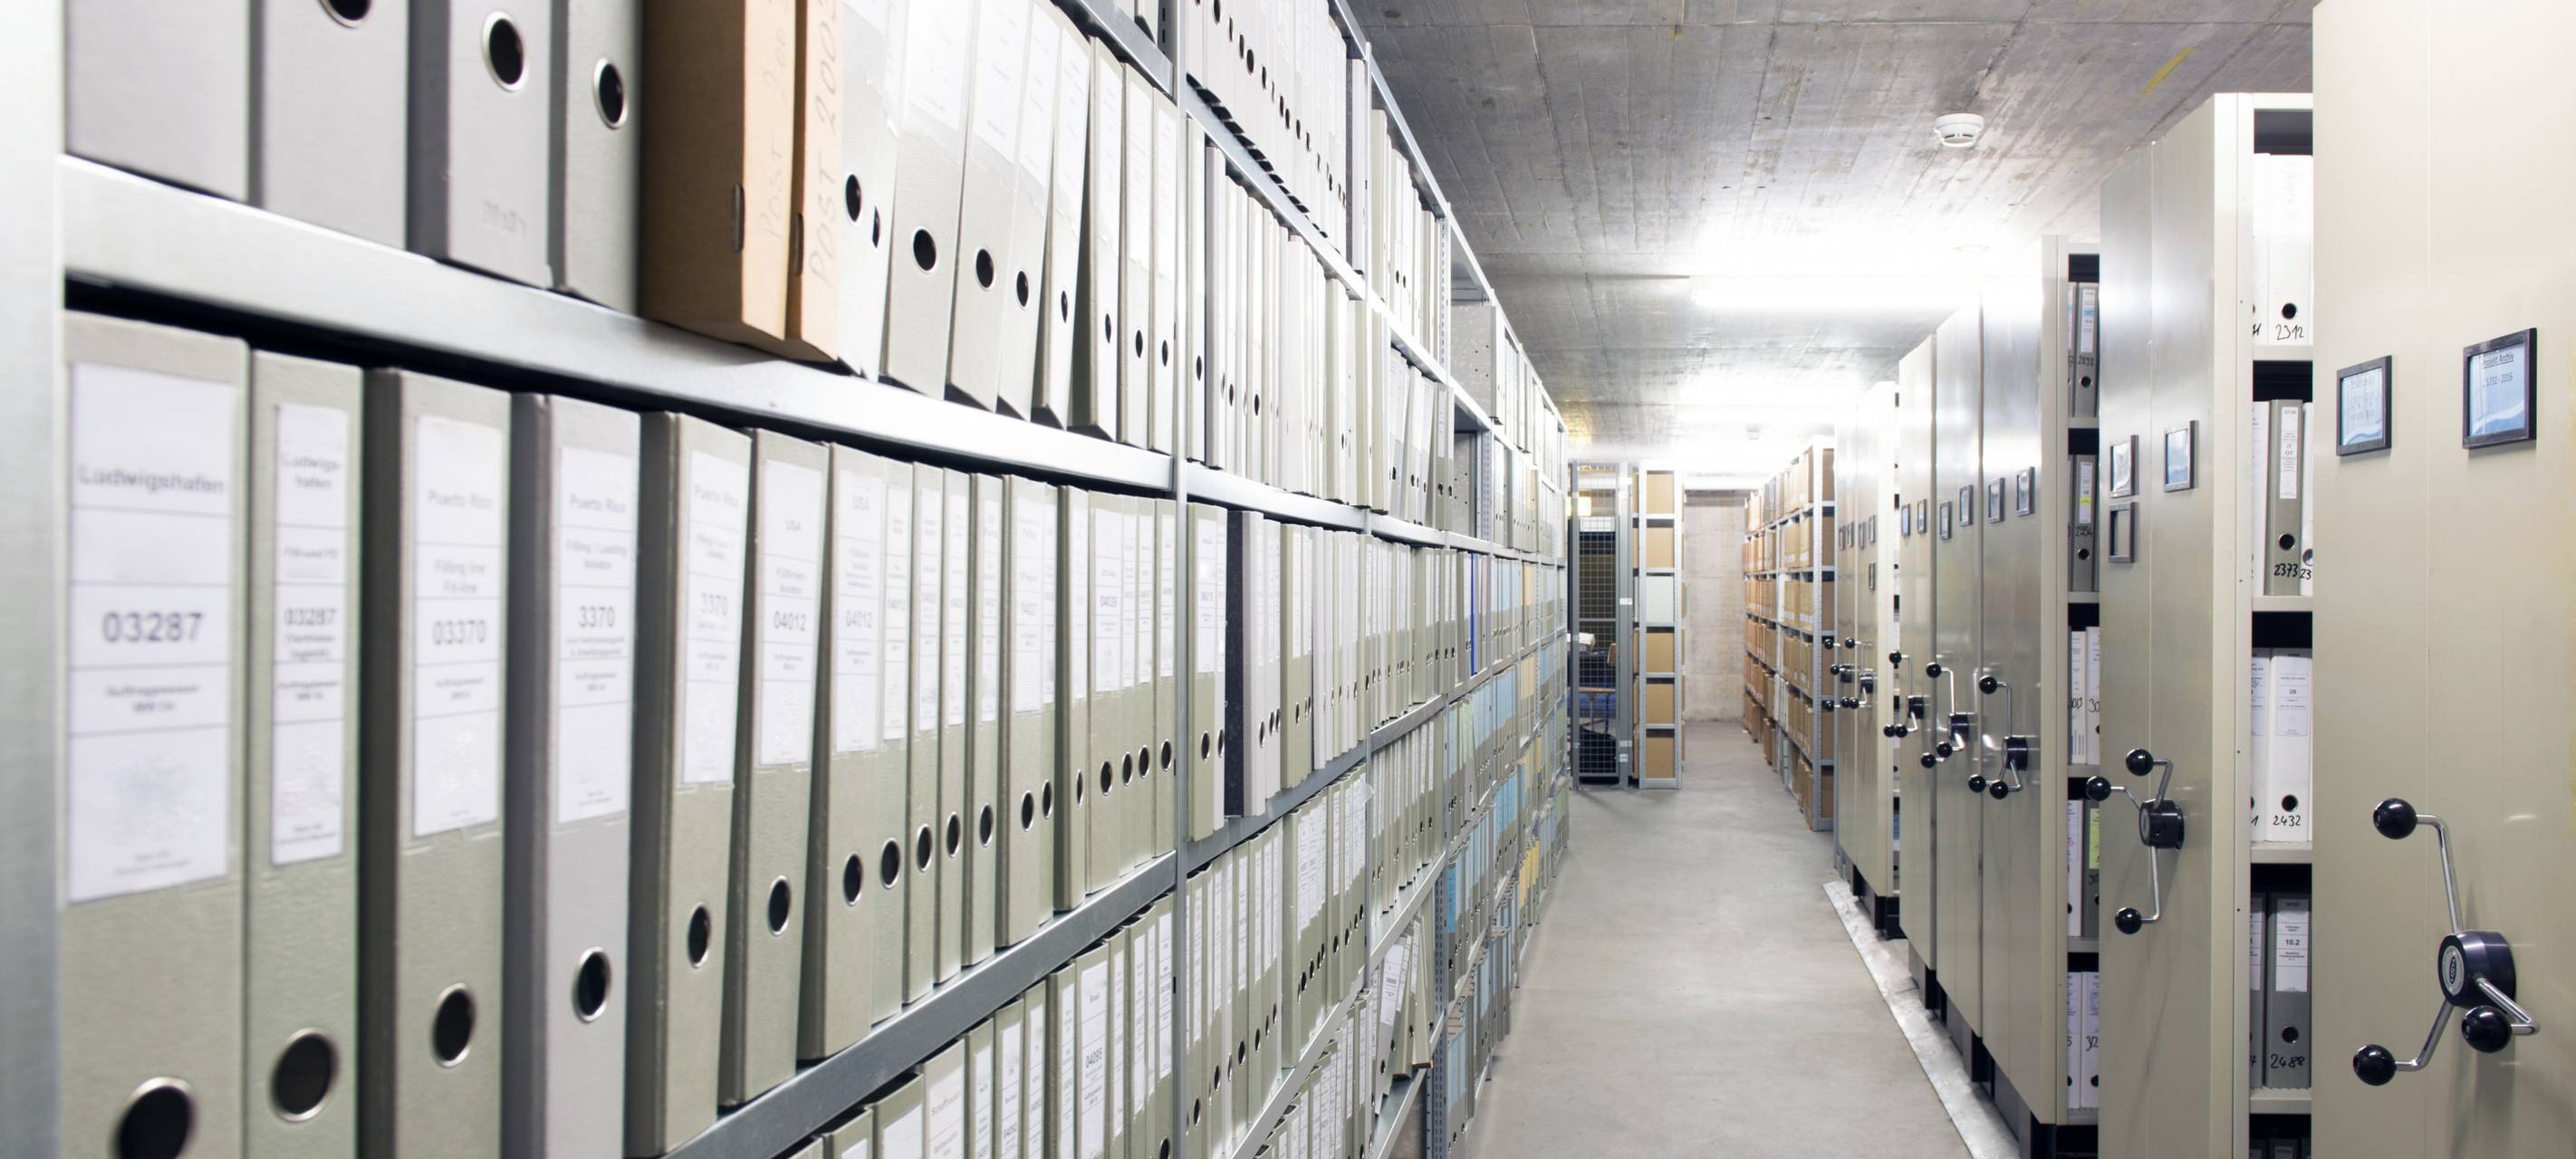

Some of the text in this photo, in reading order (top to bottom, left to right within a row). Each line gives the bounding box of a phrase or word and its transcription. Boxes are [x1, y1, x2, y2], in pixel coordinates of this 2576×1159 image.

[808, 148, 838, 288] POST
[78, 465, 225, 495] Ludwigshafen
[2274, 563, 2300, 578] 2373
[700, 592, 728, 617] 3370
[101, 609, 206, 644] 03287
[284, 607, 337, 626] 03287
[579, 605, 615, 628] 3370
[774, 609, 808, 632] 04012
[845, 608, 872, 629] 04012
[432, 618, 487, 646] 03370
[2273, 815, 2302, 827] 2432
